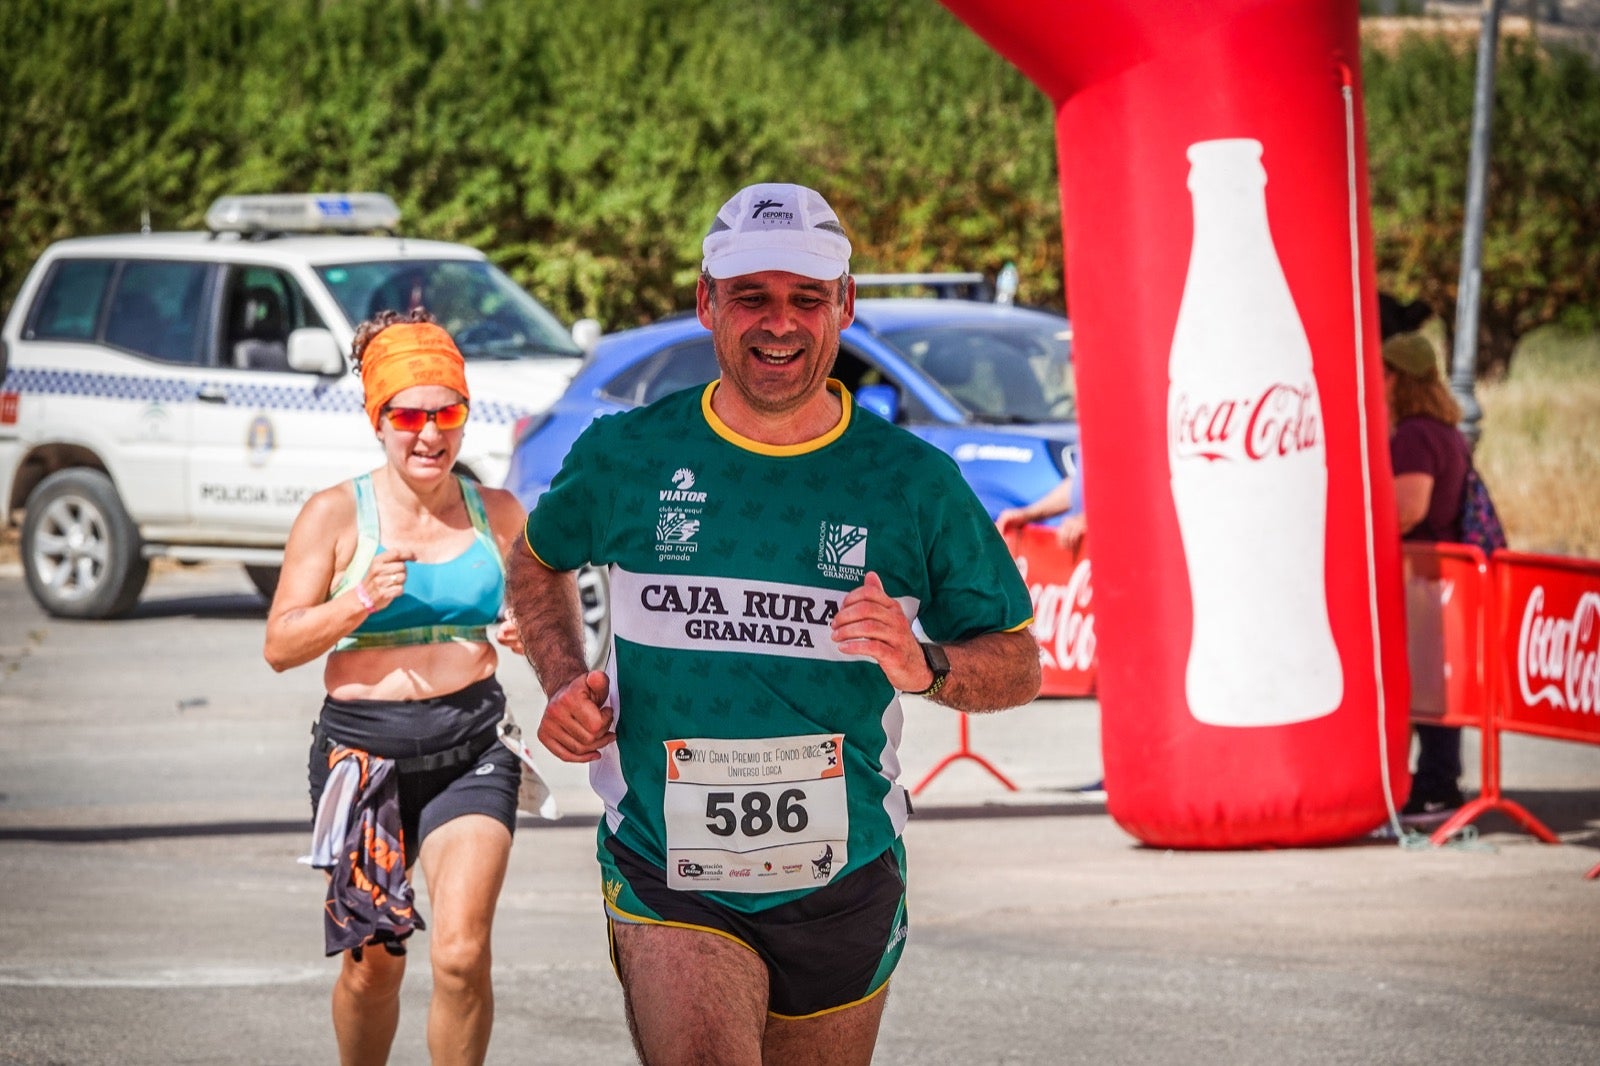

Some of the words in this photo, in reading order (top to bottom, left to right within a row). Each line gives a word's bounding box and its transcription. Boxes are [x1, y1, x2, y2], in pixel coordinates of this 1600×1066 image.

[762, 211, 794, 220] DEPORTES
[659, 490, 708, 503] VIATOR
[655, 544, 673, 553] caja
[675, 543, 698, 553] rural
[658, 553, 691, 562] granada
[817, 562, 837, 572] CAJA
[839, 566, 866, 577] RURAL
[823, 570, 860, 582] GRANADA
[640, 584, 729, 615] CAJA
[742, 590, 842, 627] RURA
[685, 619, 815, 648] GRANADA
[705, 788, 809, 837] 586
